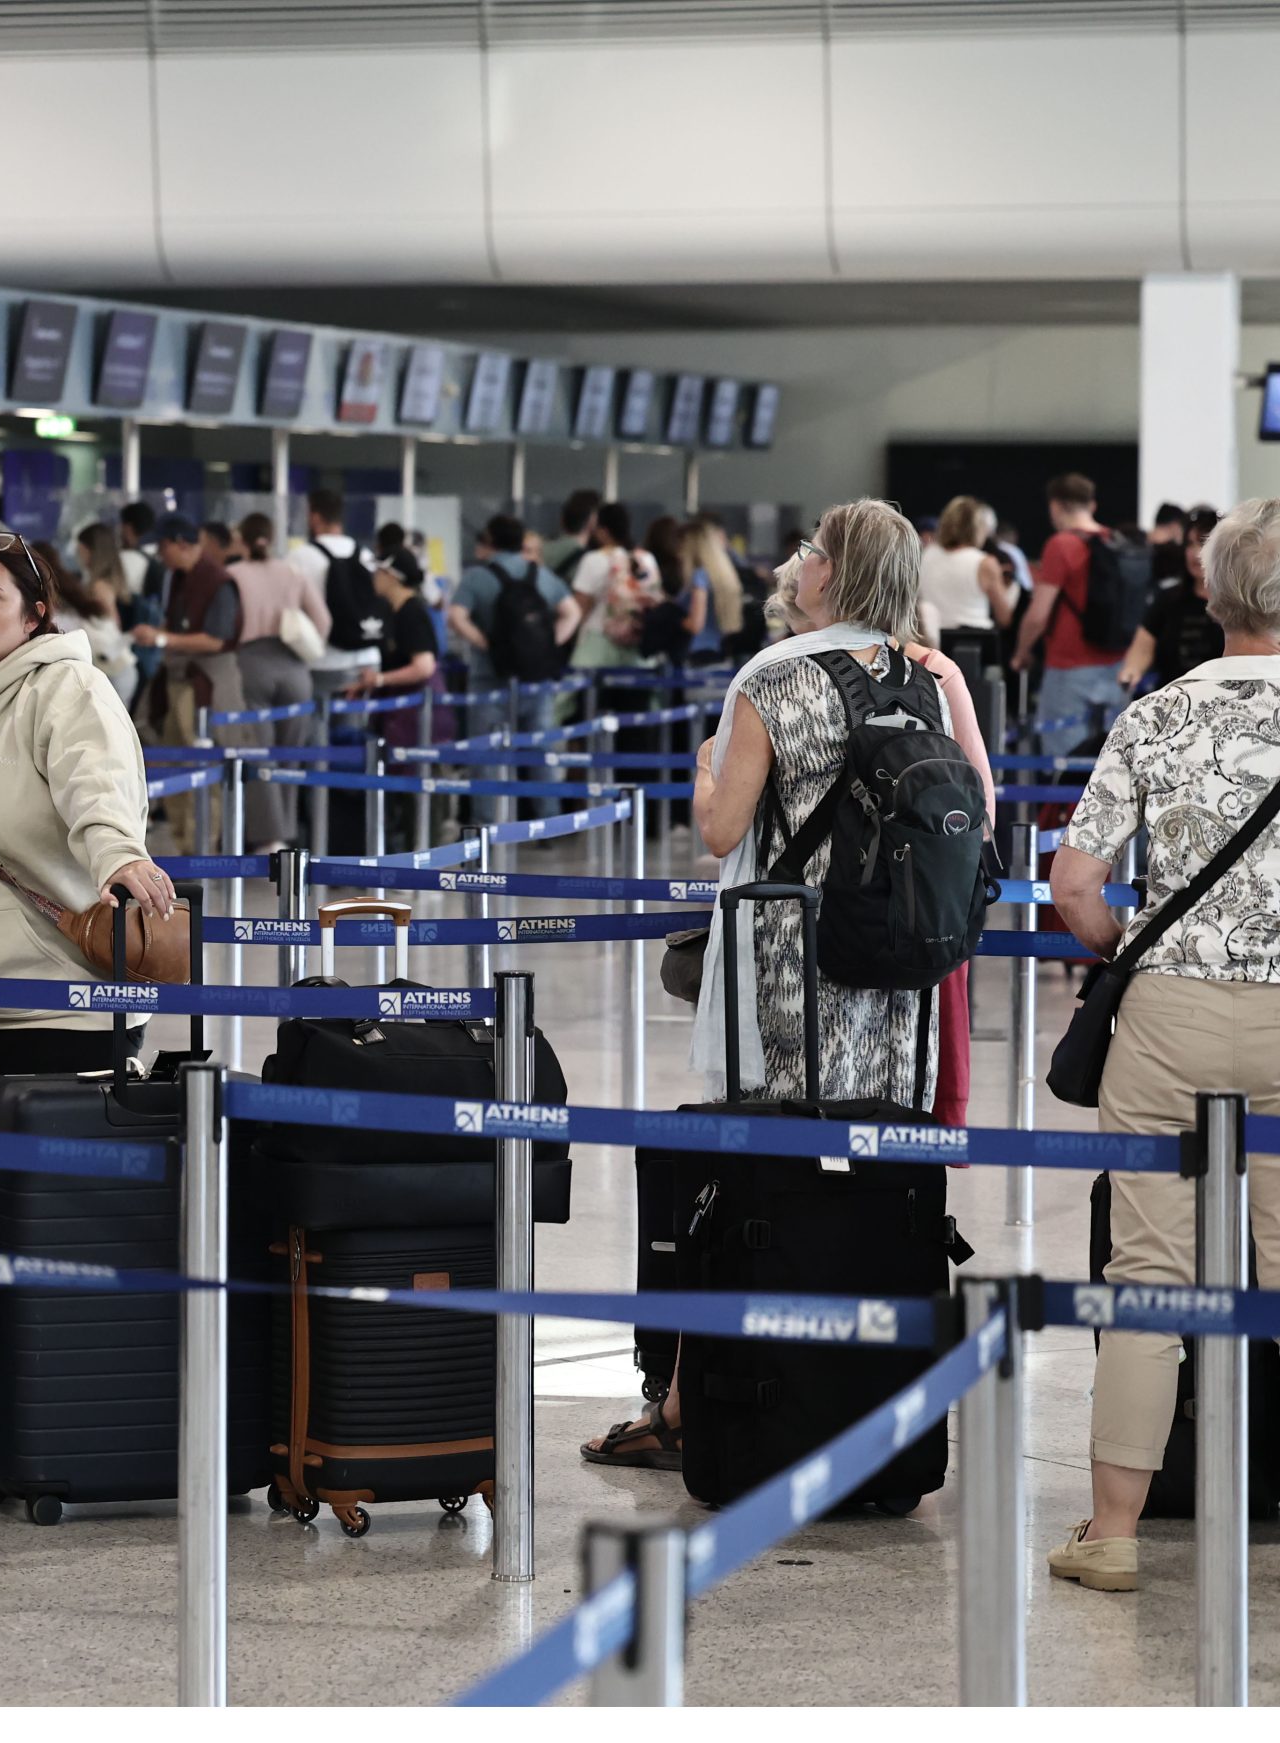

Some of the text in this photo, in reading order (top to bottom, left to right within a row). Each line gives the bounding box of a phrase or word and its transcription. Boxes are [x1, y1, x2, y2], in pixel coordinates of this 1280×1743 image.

[456, 873, 508, 885] ATHENS
[688, 882, 718, 892] ATH
[253, 920, 312, 932] ATHENS
[518, 917, 577, 933] ATHENS
[92, 985, 160, 999] ATHENS
[402, 991, 473, 1004] ATHENS
[484, 1102, 570, 1125] ATHENS
[880, 1126, 969, 1145] ATHENS
[1116, 1286, 1235, 1315] ATHENS
[742, 1312, 856, 1341] ATHENS
